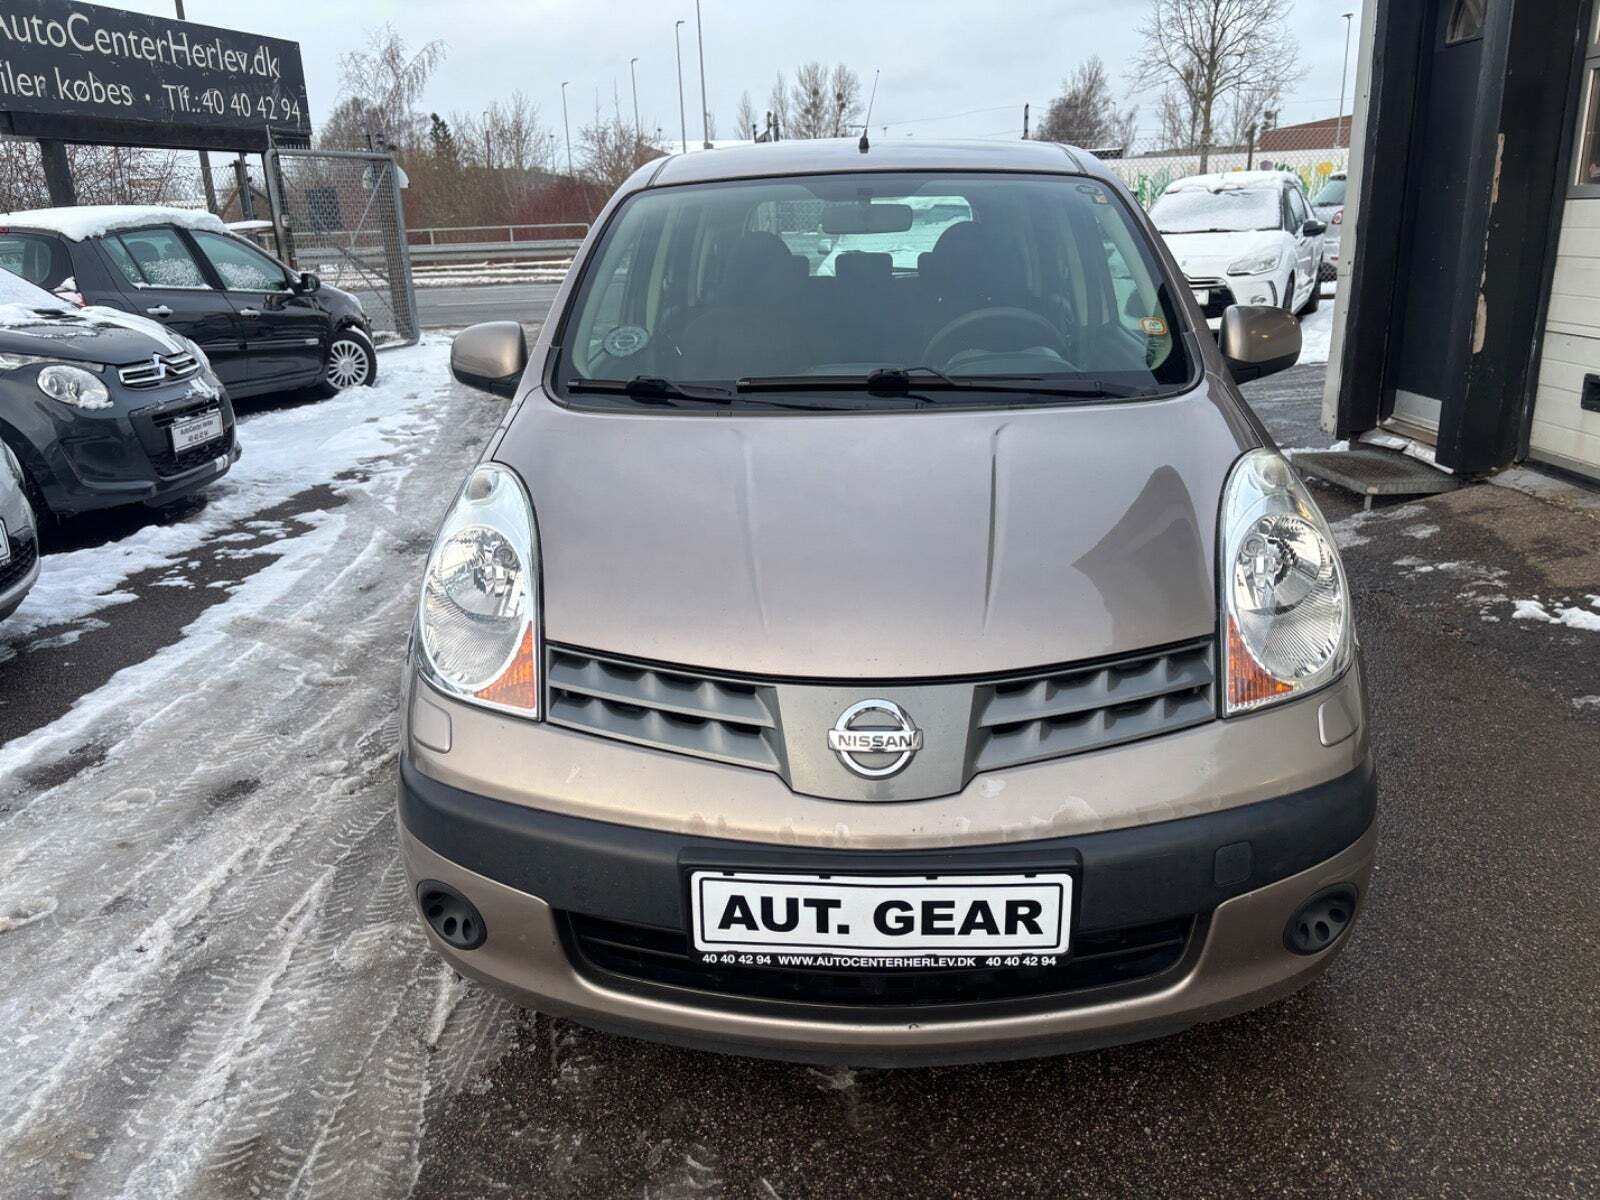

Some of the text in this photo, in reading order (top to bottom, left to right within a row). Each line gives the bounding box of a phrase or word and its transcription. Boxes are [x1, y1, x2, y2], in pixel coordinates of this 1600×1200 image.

[54, 66, 134, 106] købes
[230, 92, 251, 117] 40
[257, 95, 278, 120] 42
[280, 98, 301, 128] 94
[838, 734, 912, 748] NISSAN
[717, 894, 1044, 936] AUT. GEAR
[702, 953, 1057, 968] 40 40 42 94 WWW.AUTOCENTERHERLEV.DK 40 40 42 94
